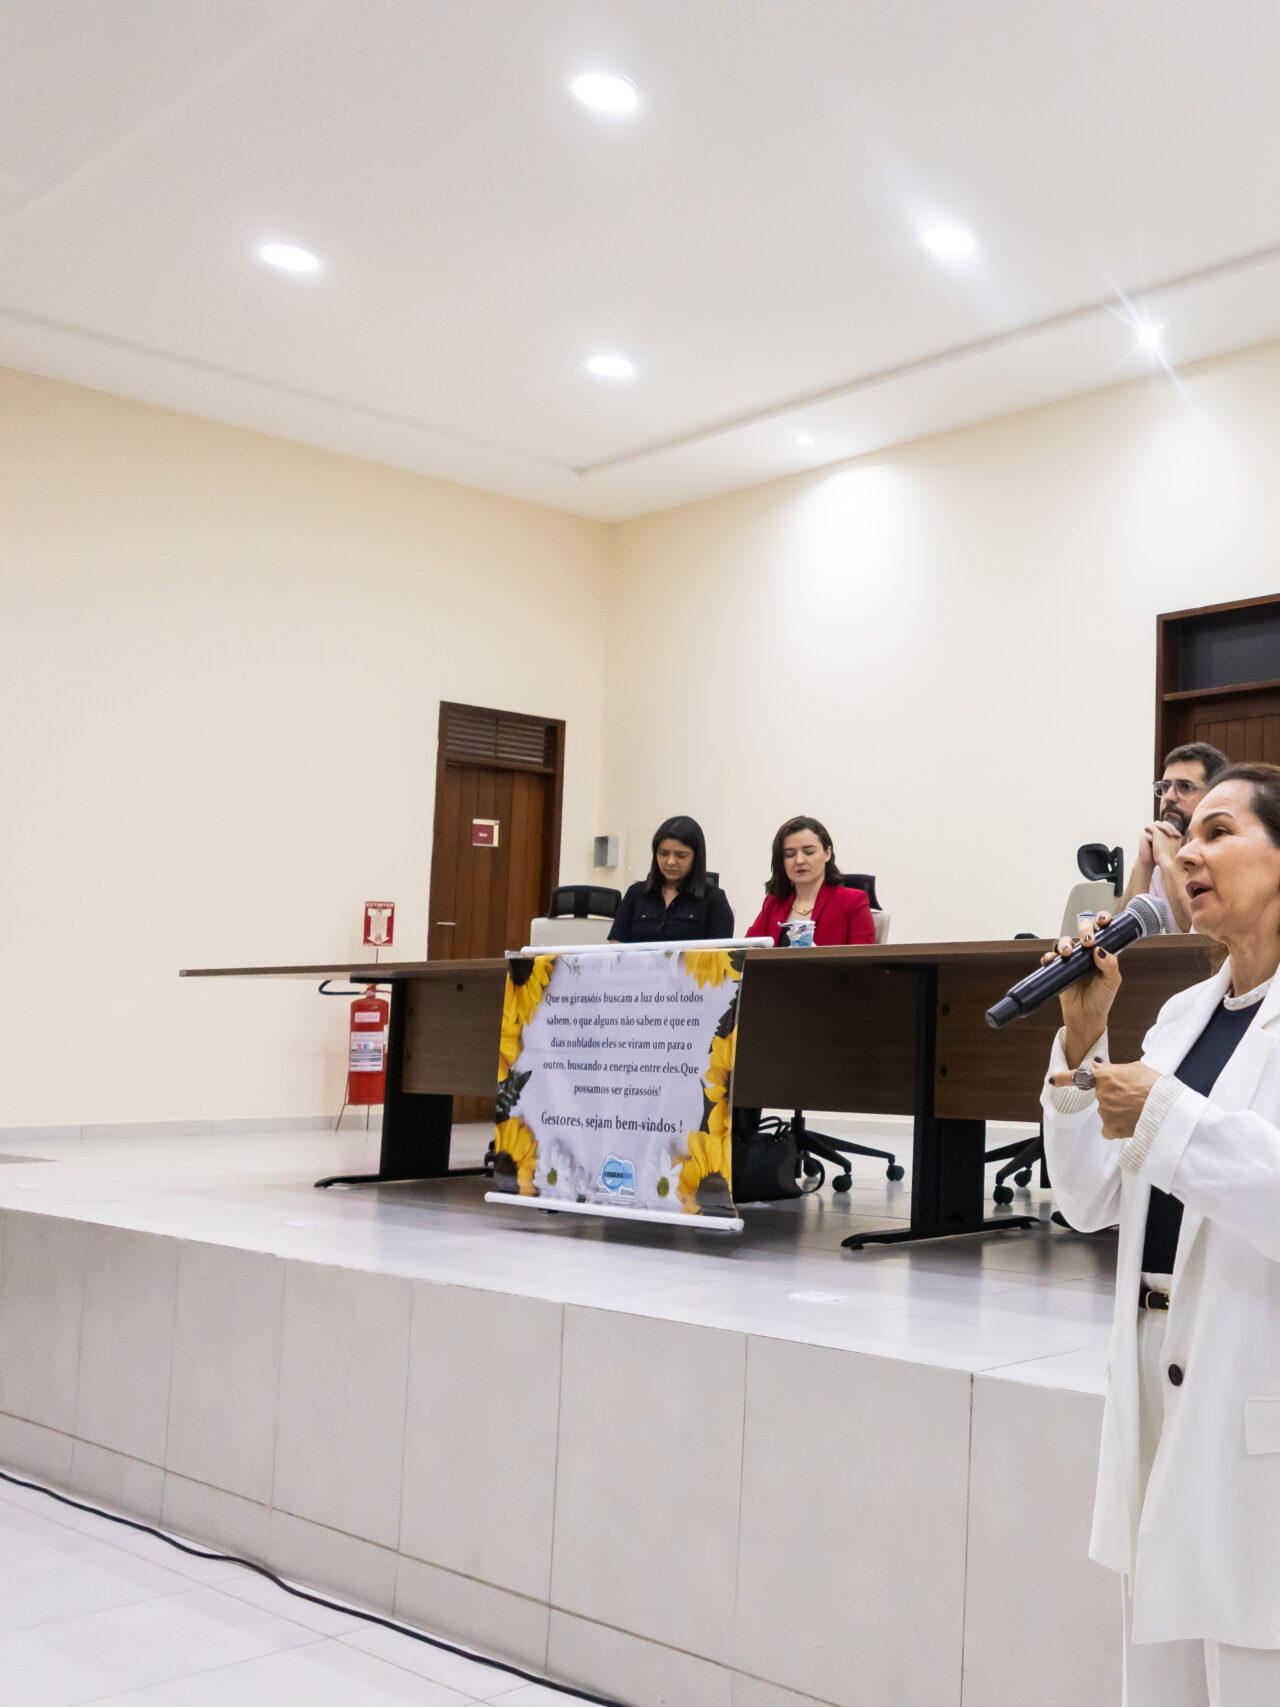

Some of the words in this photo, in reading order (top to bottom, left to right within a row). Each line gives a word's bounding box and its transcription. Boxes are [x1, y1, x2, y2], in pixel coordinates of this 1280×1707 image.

[545, 993, 560, 1005] Que
[570, 993, 601, 1005] girassóis
[604, 992, 632, 1003] buscam
[634, 995, 639, 1003] a
[641, 993, 653, 1002] luz
[655, 993, 664, 1002] do
[666, 993, 678, 1002] sol
[680, 993, 703, 1003] todos
[547, 1016, 571, 1027] sabem,
[579, 1019, 592, 1027] que
[594, 1016, 618, 1028] alguns
[620, 1016, 634, 1026] não
[636, 1016, 661, 1026] sabem
[664, 1016, 668, 1026] é
[670, 1018, 685, 1029] que
[687, 1018, 700, 1026] em
[551, 1038, 565, 1047] dias
[567, 1038, 600, 1049] nublados
[602, 1039, 616, 1049] eles
[618, 1041, 626, 1049] se
[628, 1040, 651, 1049] viram
[667, 1042, 685, 1052] para
[543, 1060, 566, 1071] outro,
[567, 1060, 601, 1071] buscando
[610, 1062, 638, 1075] energia
[640, 1064, 660, 1073] entre
[663, 1063, 699, 1075] eles.Que
[574, 1085, 609, 1096] possamos
[611, 1087, 622, 1095] ser
[624, 1085, 661, 1097] girassóis!
[541, 1112, 583, 1127] Gestores,
[585, 1116, 612, 1129] sejam
[616, 1116, 675, 1133] bem-vindos
[679, 1120, 682, 1133] !
